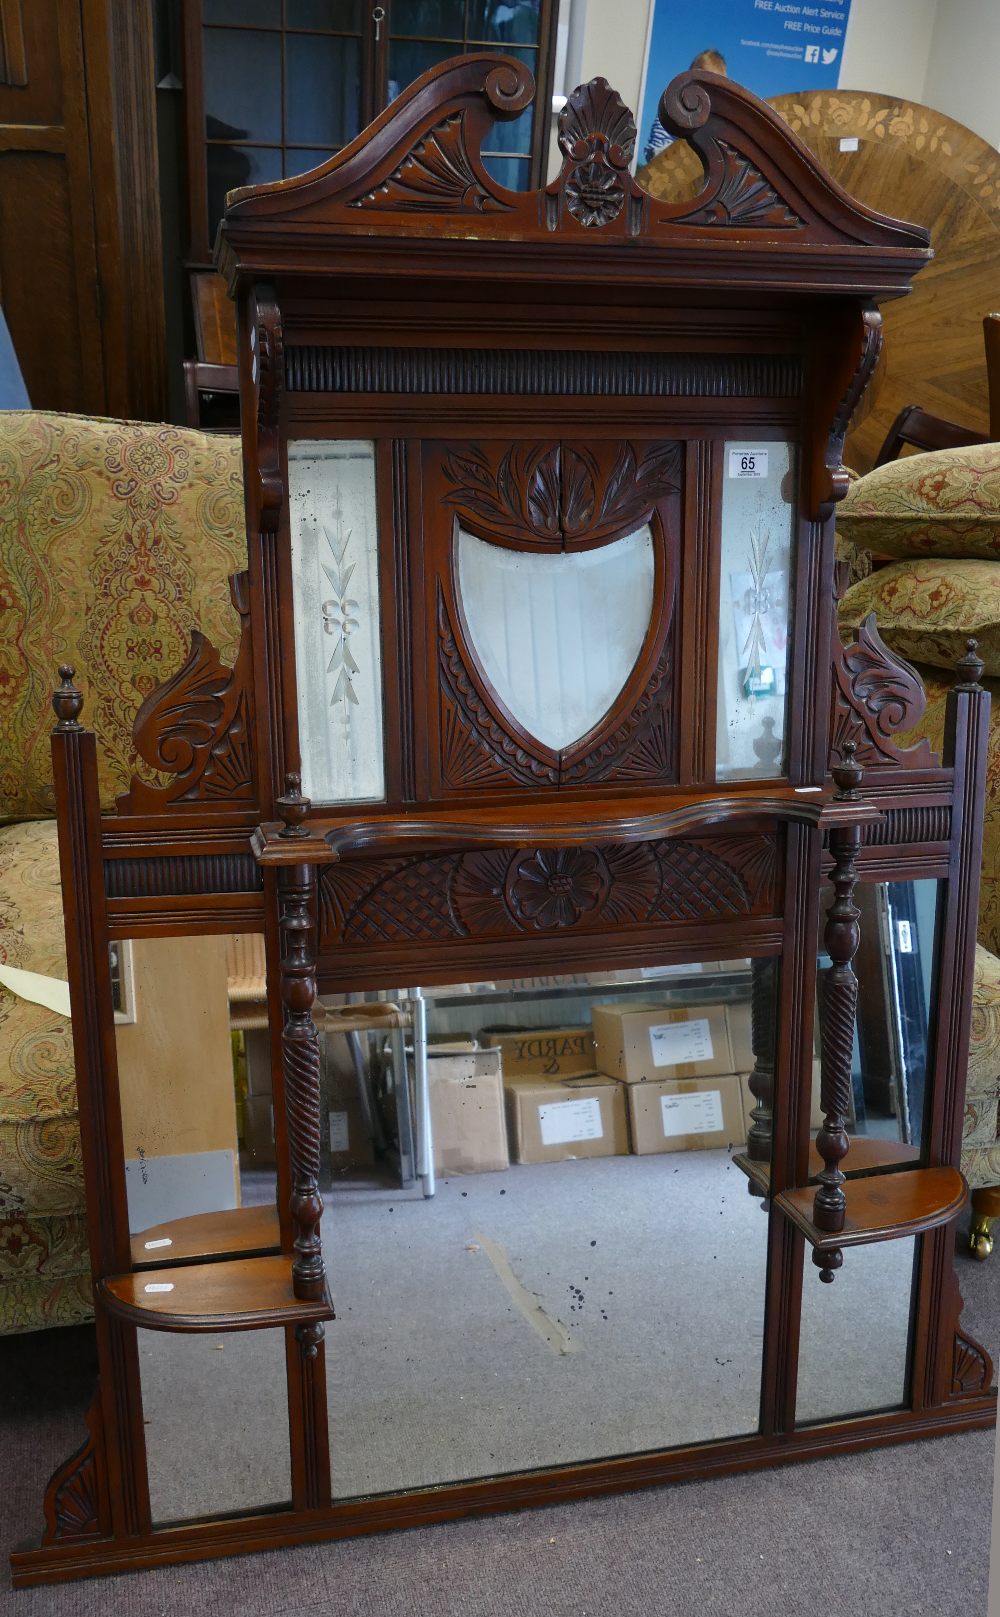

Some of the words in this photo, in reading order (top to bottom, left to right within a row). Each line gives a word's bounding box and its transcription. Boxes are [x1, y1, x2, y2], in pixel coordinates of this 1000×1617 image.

[754, 0, 774, 11] FREE
[774, 2, 801, 14] Auction
[802, 6, 819, 17] Alert
[820, 9, 845, 20] Service
[784, 20, 802, 31] FREE
[804, 23, 821, 33] Price
[822, 26, 842, 36] Guide
[741, 456, 755, 470] 65
